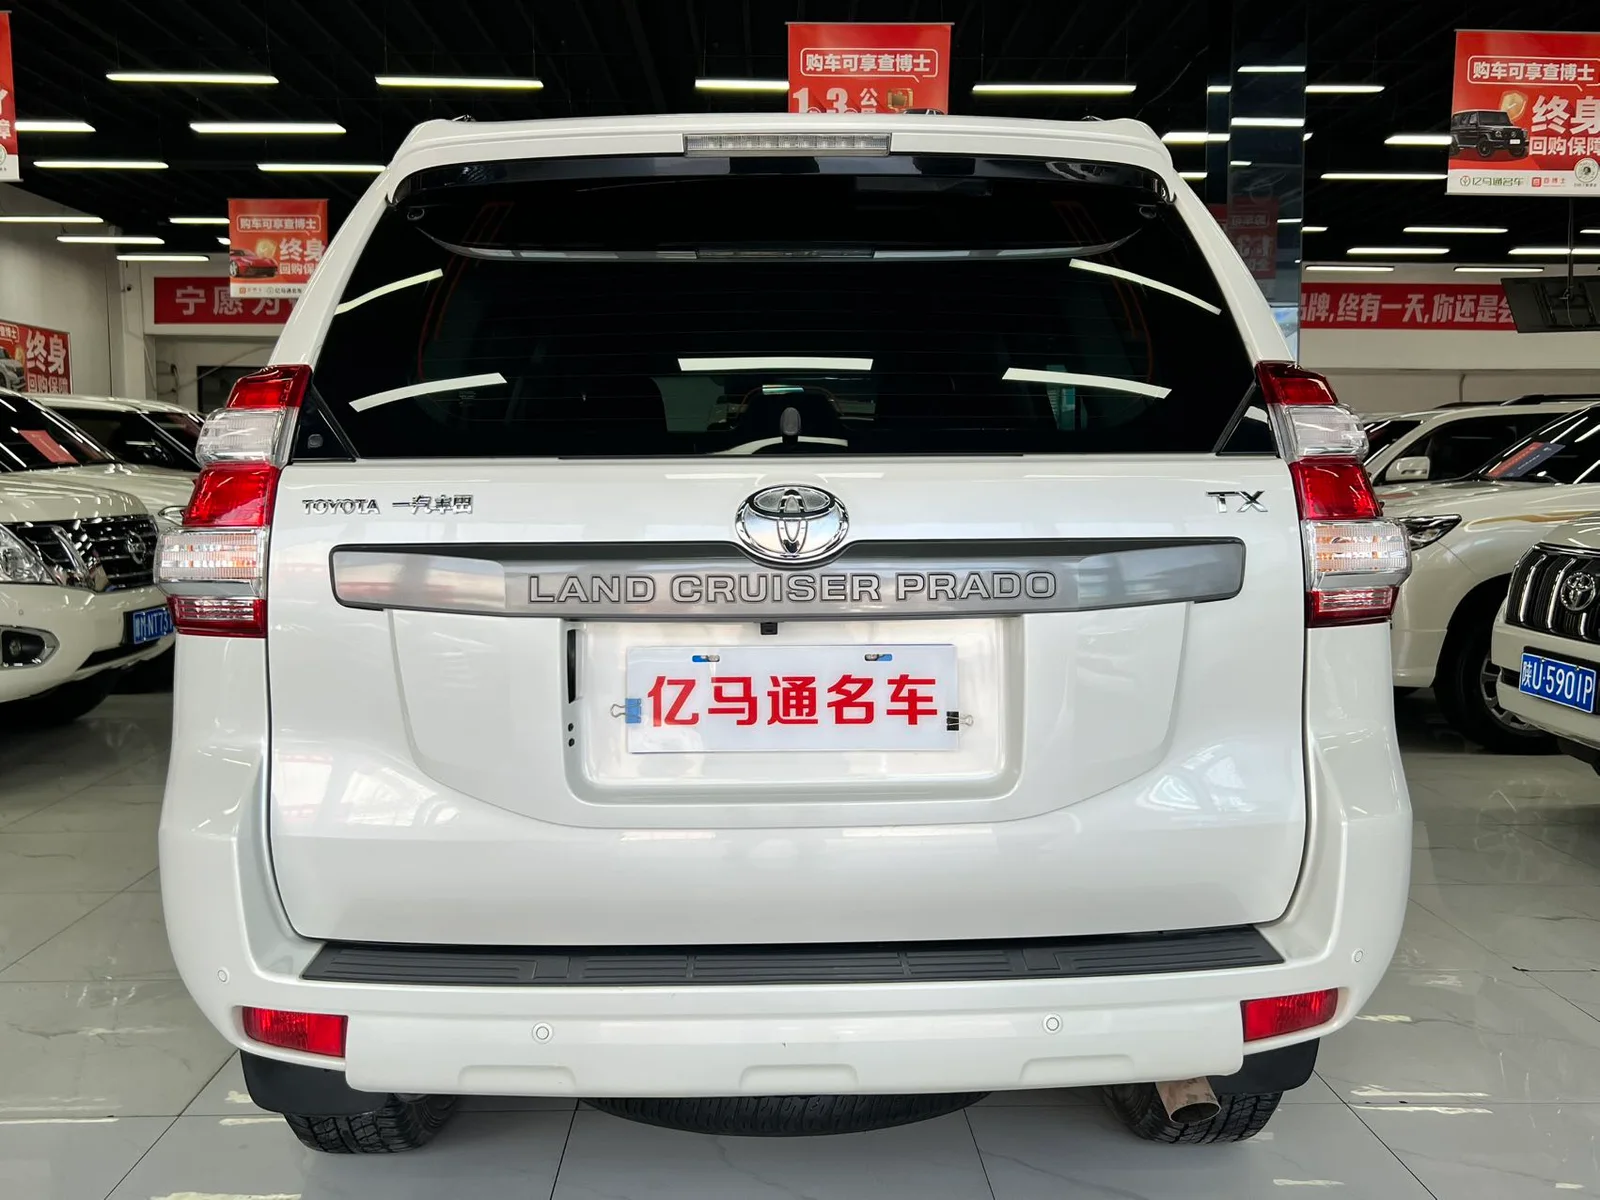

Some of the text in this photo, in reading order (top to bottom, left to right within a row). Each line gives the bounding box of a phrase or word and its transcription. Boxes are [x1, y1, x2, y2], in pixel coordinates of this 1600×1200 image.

[806, 53, 931, 73] 购车可享查博士
[1473, 61, 1595, 82] 购车可享查博士
[1531, 95, 1600, 135] 终身
[1528, 136, 1600, 156] 回购保障
[240, 217, 317, 230] 购车可享查博士
[279, 238, 326, 262] 终身
[1300, 292, 1514, 323] 牌,终有一天,你还是会
[26, 329, 67, 375] 终身
[302, 498, 380, 515] TOYOTA
[1206, 490, 1268, 513] TX
[528, 571, 1057, 604] LAND CRUISER PRADO
[647, 674, 938, 728] 亿马通名车
